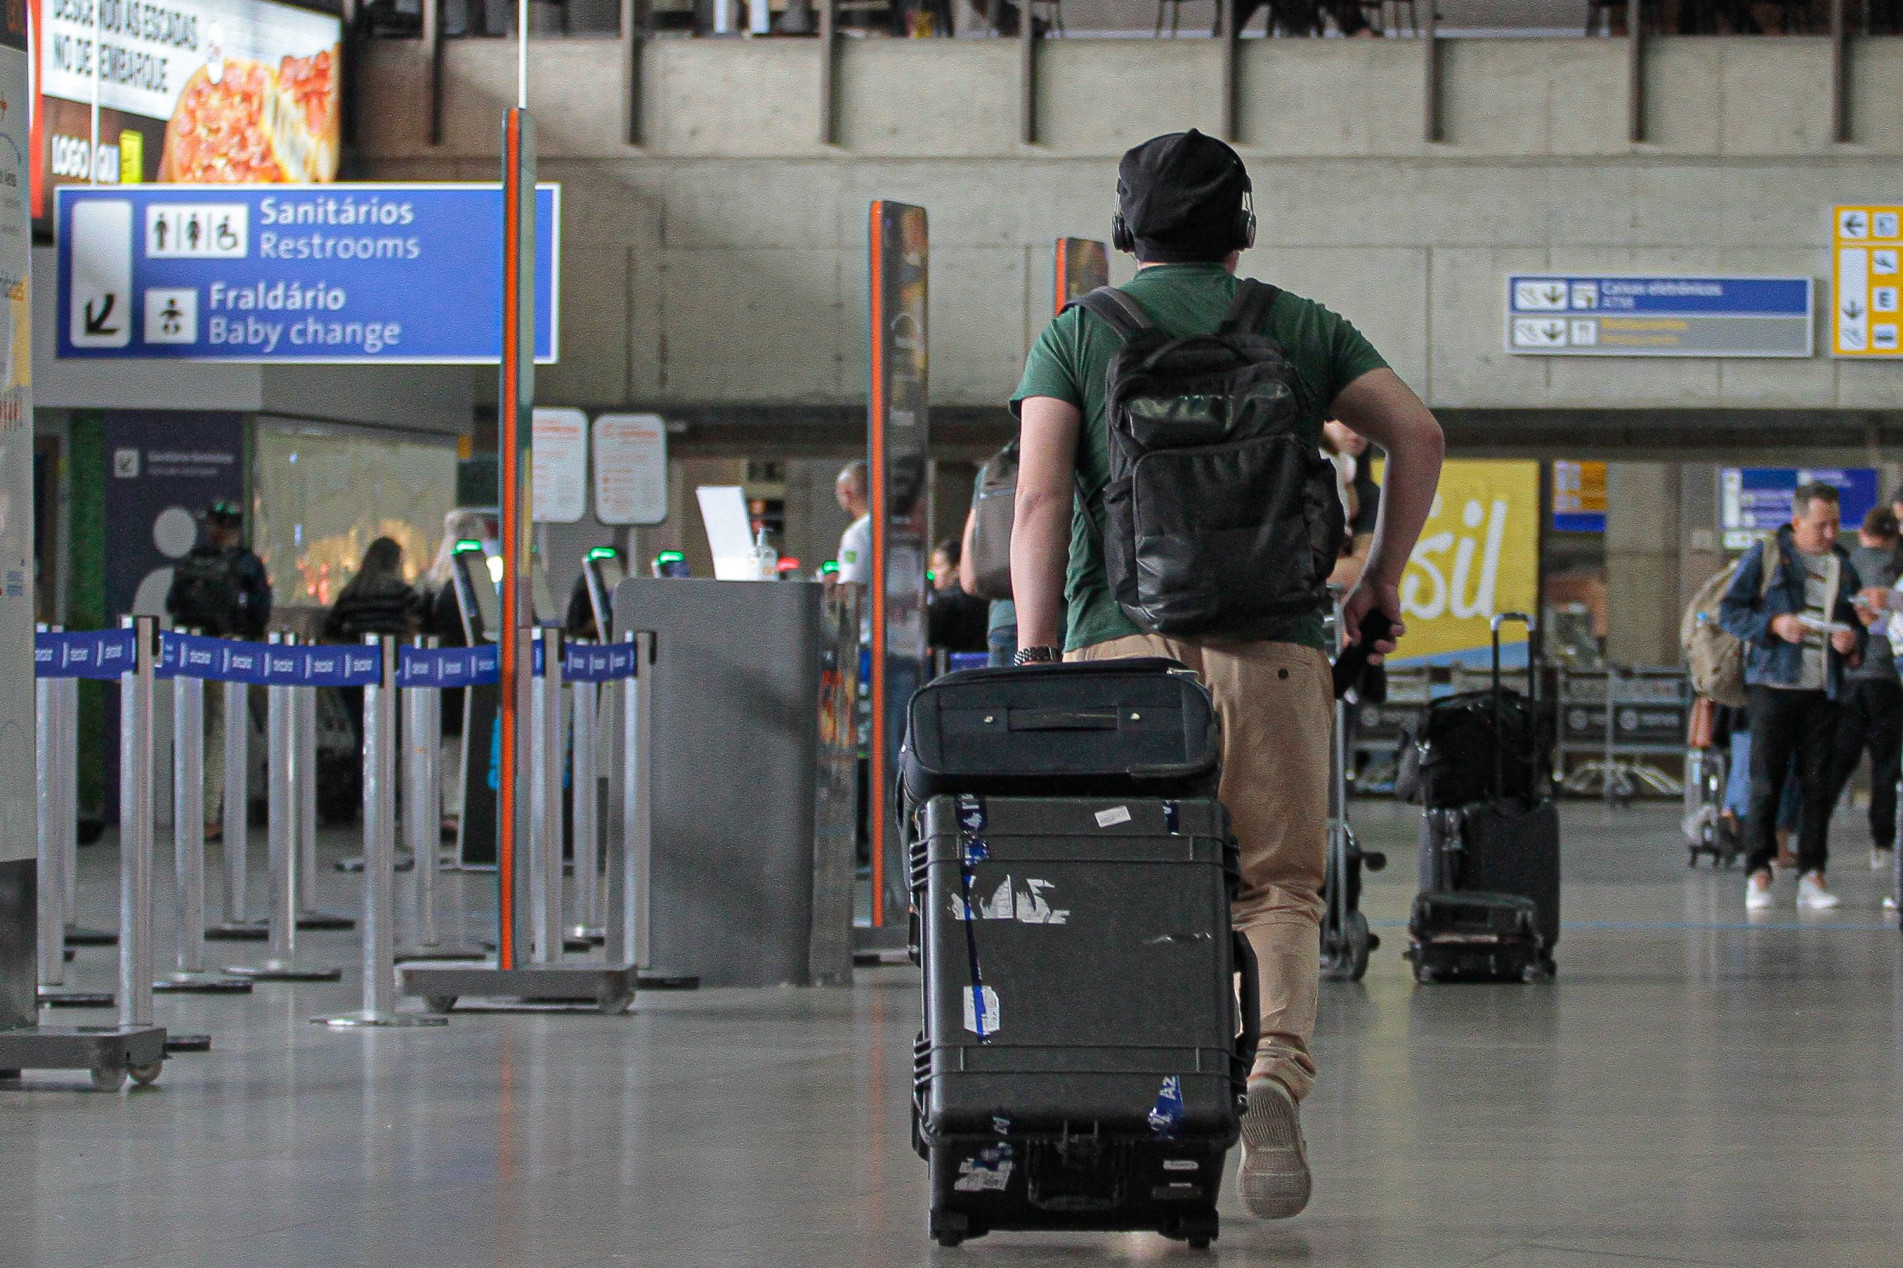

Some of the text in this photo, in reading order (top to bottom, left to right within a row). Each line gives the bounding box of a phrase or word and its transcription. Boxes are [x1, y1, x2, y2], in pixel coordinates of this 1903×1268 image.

[260, 196, 415, 225] Sanitários
[260, 231, 421, 260] Restrooms
[209, 279, 346, 311] Fraldário
[209, 316, 401, 354] Baby change
